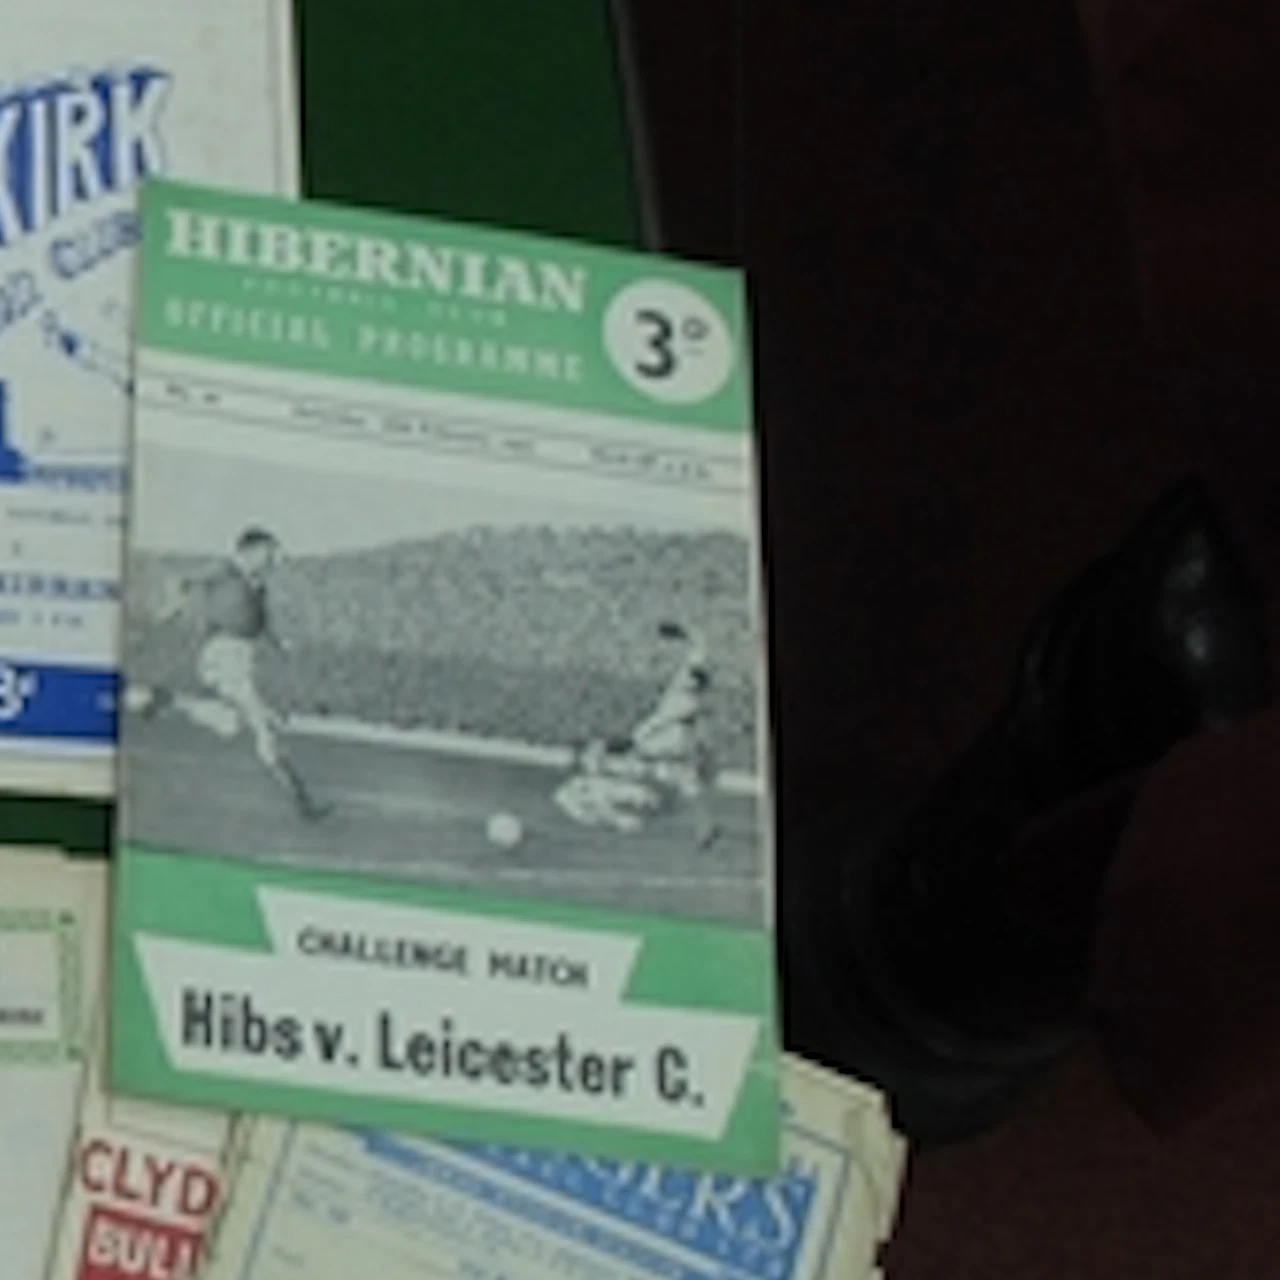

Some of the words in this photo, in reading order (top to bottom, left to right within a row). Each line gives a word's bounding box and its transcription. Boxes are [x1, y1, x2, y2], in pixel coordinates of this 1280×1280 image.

[164, 208, 589, 314] HIBERNIAN
[164, 298, 331, 350] OFFICIAL
[356, 326, 585, 383] PROGRAMME
[296, 925, 470, 977] CHALLENGE
[487, 948, 590, 989] MATCH
[180, 986, 304, 1062] Hibs
[312, 1019, 360, 1068] v.
[377, 1008, 636, 1098] Leicester
[655, 1045, 706, 1108] C.
[77, 1138, 220, 1219] CLYD
